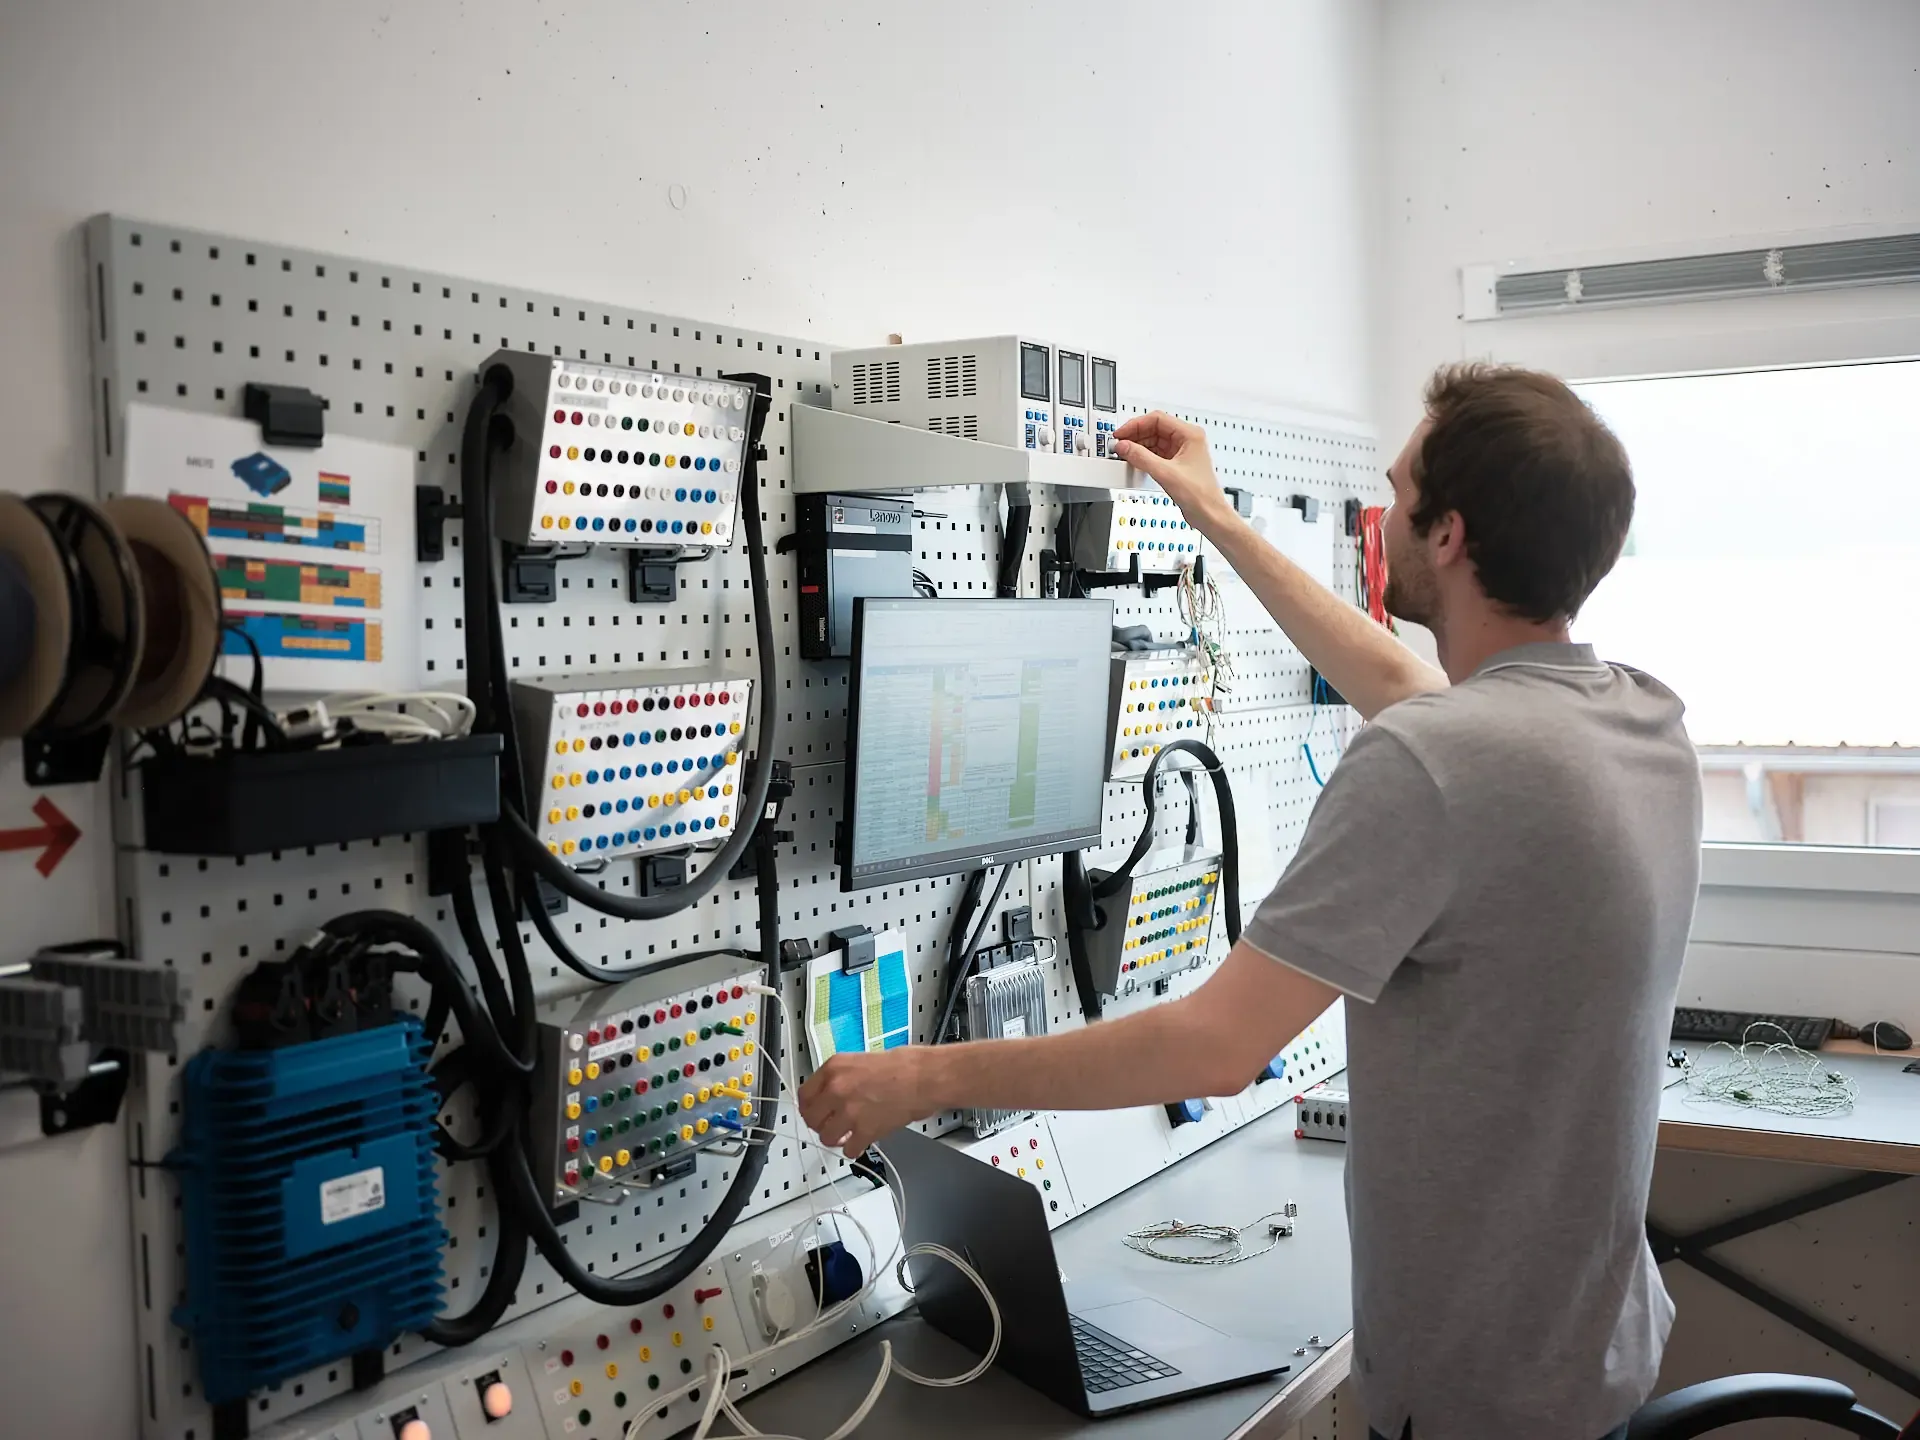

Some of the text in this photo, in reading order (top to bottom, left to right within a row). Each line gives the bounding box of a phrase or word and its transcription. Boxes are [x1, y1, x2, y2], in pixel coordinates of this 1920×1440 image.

[869, 508, 901, 524] Lenovo
[768, 805, 776, 815] Y
[981, 855, 995, 866] DELL
